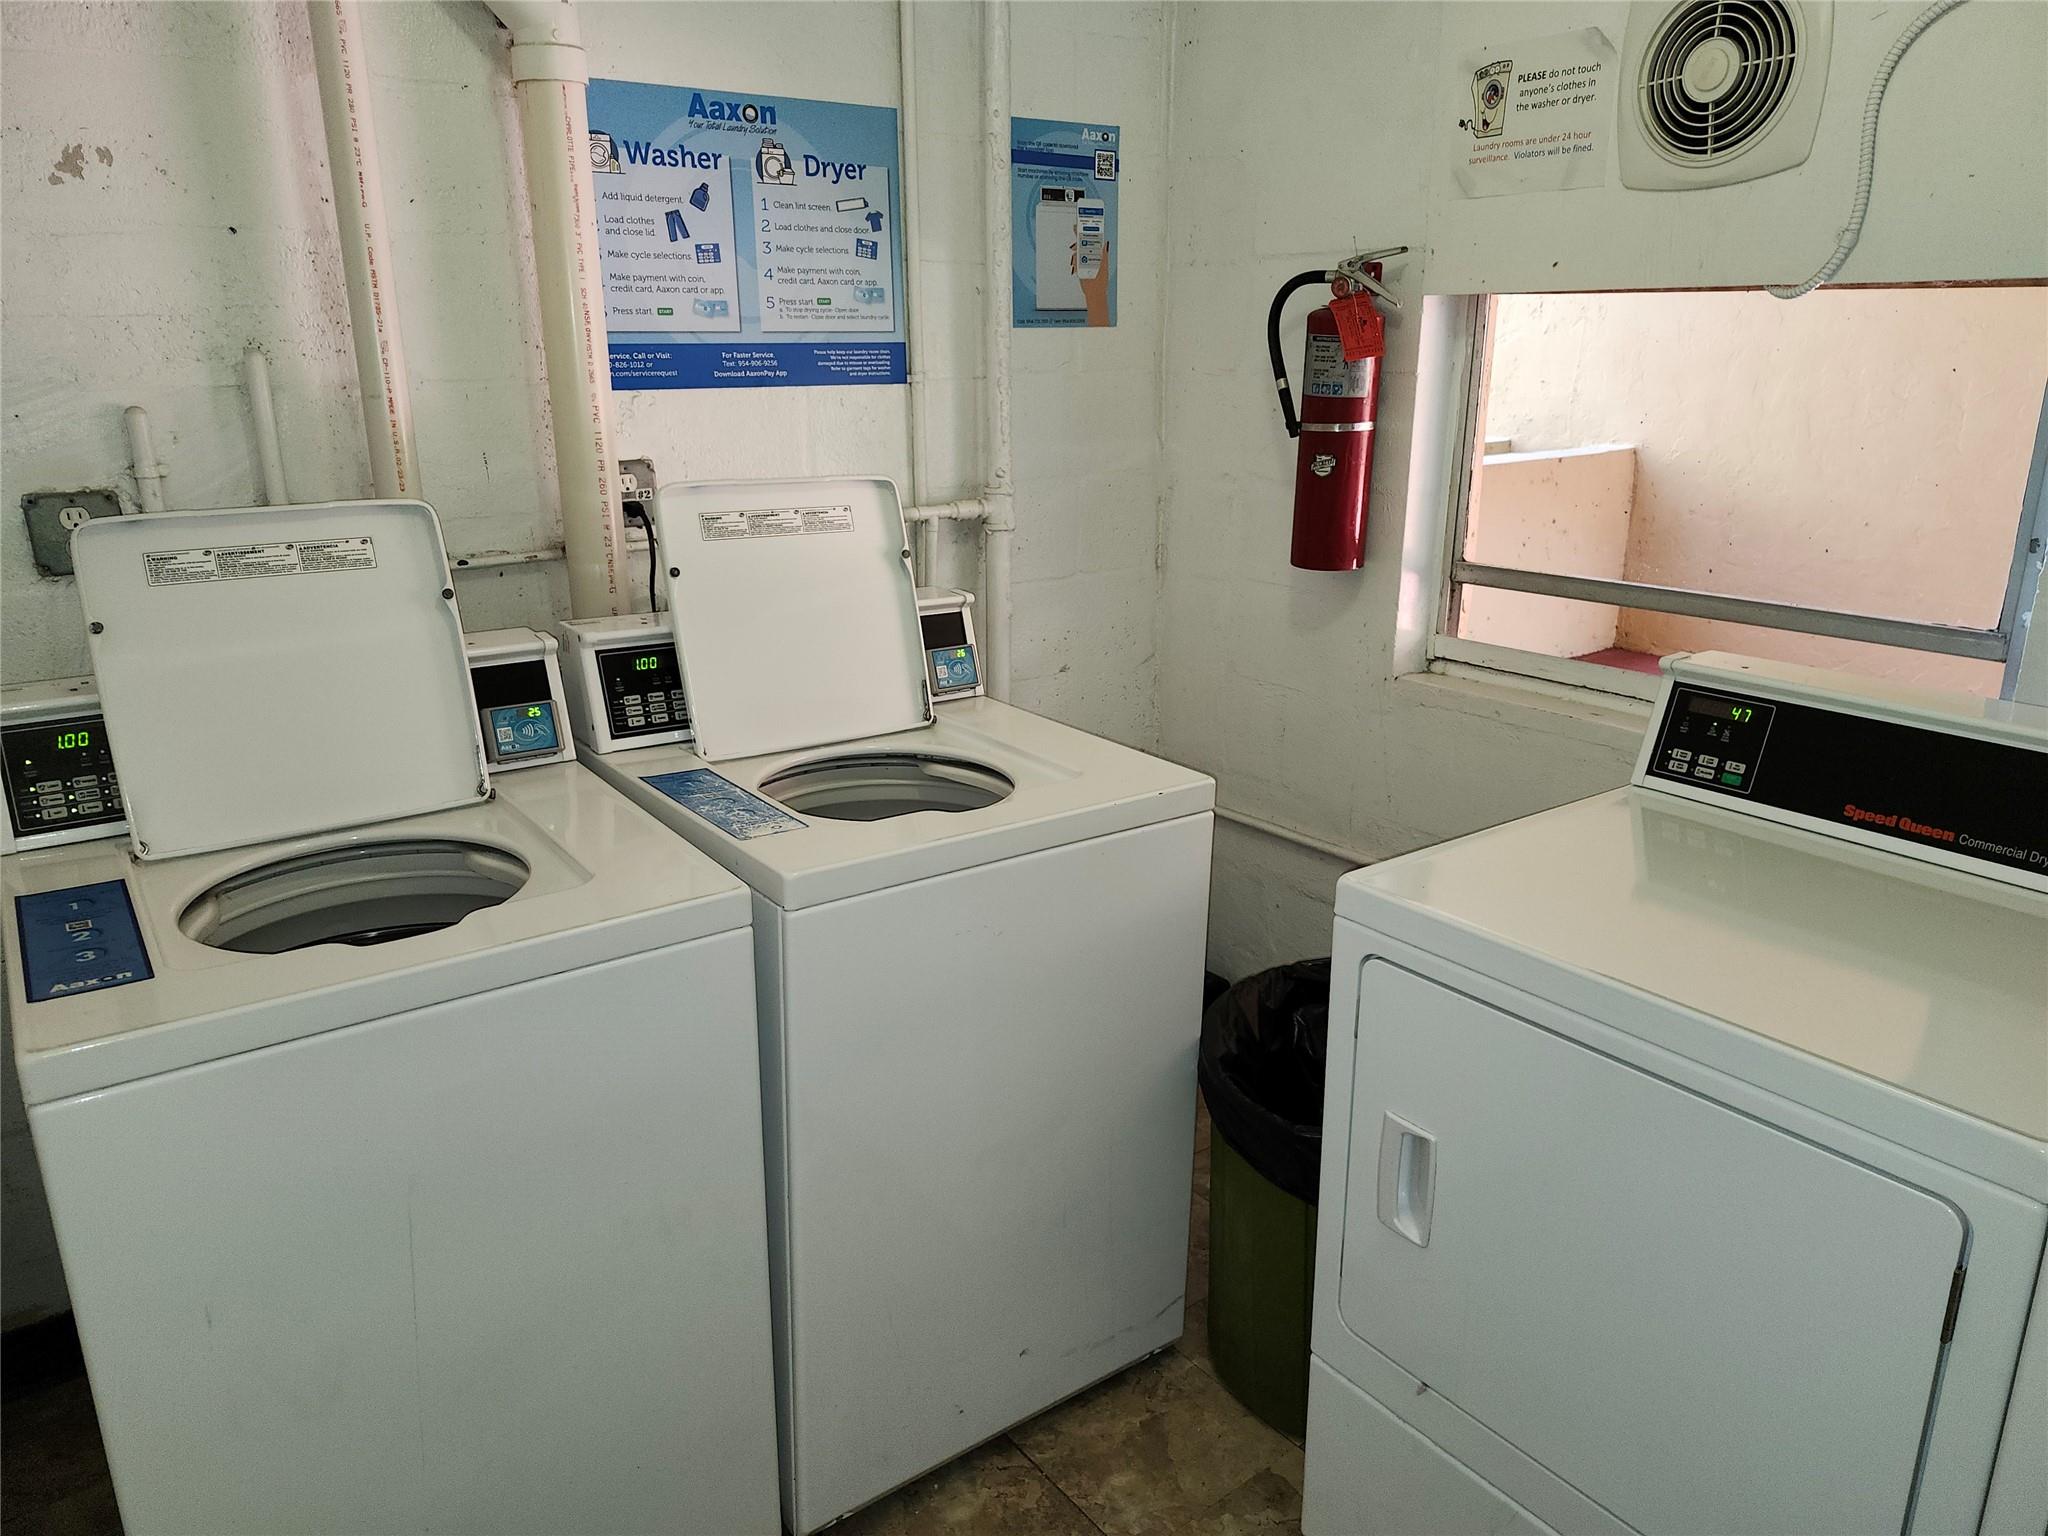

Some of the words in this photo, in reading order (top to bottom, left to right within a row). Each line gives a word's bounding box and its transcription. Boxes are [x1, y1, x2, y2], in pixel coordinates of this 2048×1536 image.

[339, 37, 347, 55] PVC
[342, 59, 351, 79] 1120
[1518, 70, 1547, 83] PLEASE
[1548, 69, 1560, 78] do
[1561, 66, 1576, 77] not
[1578, 61, 1602, 74] touch
[345, 82, 353, 95] PR
[1519, 84, 1555, 98] anyone's
[1556, 80, 1586, 91] clothes
[1588, 78, 1596, 87] in
[688, 92, 777, 125] Aaxon
[1516, 103, 1529, 112] the
[1531, 98, 1559, 109] washer
[1561, 97, 1571, 105] or
[1572, 93, 1597, 104] dryer.
[349, 116, 358, 132] PSI
[688, 120, 703, 128] Your
[706, 120, 721, 131] Total
[722, 124, 748, 136] Laundry
[563, 115, 575, 153] CHARLOTTE
[1082, 127, 1115, 144] Aaxon
[1473, 142, 1501, 152] Laundry
[1502, 139, 1524, 148] rooms
[1538, 135, 1560, 144] under
[1562, 133, 1572, 141] 24
[1573, 131, 1592, 139] hour
[623, 140, 722, 170] Washer
[1469, 154, 1510, 165] surveillance.
[1513, 148, 1546, 159] Violators
[1547, 147, 1560, 156] will
[1562, 145, 1571, 154] be
[1572, 143, 1594, 153] fined.
[803, 154, 867, 184] Dryer
[602, 191, 619, 200] Add
[621, 192, 643, 202] liquid
[644, 193, 684, 204] detergent.
[761, 198, 769, 211] 1
[773, 200, 793, 210] Clean
[795, 201, 807, 210] lint
[604, 215, 624, 224] Load
[626, 216, 655, 225] clothes
[761, 219, 771, 233] 2
[774, 222, 792, 231] Load
[793, 223, 818, 233] clothes
[820, 225, 833, 233] and
[605, 227, 621, 236] and
[622, 228, 643, 237] close
[366, 245, 375, 265] Code
[575, 242, 583, 255] PVC
[607, 250, 629, 259] Make
[630, 251, 651, 262] cycle
[762, 241, 772, 255] 3
[775, 245, 794, 253] Make
[796, 245, 814, 256] cycle
[577, 257, 585, 272] TYPE
[369, 268, 378, 289] ASTM
[609, 273, 631, 281] Make
[632, 274, 667, 284] payment
[669, 274, 686, 282] with
[763, 268, 774, 281] 4
[777, 266, 796, 274] Make
[797, 268, 827, 276] payment
[610, 284, 633, 293] credit
[656, 285, 681, 294] Aaxon
[682, 285, 699, 294] card
[777, 277, 798, 285] credit
[817, 277, 839, 285] Aaxon
[839, 278, 855, 286] card
[766, 296, 775, 309] 5
[778, 297, 797, 306] Press
[612, 306, 634, 315] Press
[632, 352, 646, 360] Call
[656, 352, 673, 360] Visit:
[610, 370, 678, 378] n.com/servicerequest
[714, 370, 745, 378] Download
[745, 370, 775, 378] AaxonPay
[775, 370, 788, 378] App
[386, 396, 395, 415] MADE
[591, 404, 601, 424] PVC
[389, 418, 397, 428] IN
[593, 430, 604, 454] 1120
[596, 458, 605, 472] PR
[597, 476, 608, 496] 260
[600, 500, 610, 518] PSI
[528, 706, 541, 717] 25
[1731, 707, 1752, 723] 47
[57, 731, 89, 749] 1.00
[1843, 804, 1898, 827] Speed
[1899, 817, 1956, 842] Queen
[1959, 833, 2028, 860] Commercial
[68, 902, 78, 911] 1
[72, 931, 91, 942] 2
[75, 951, 97, 962] 3
[49, 971, 133, 993] Aaxon
